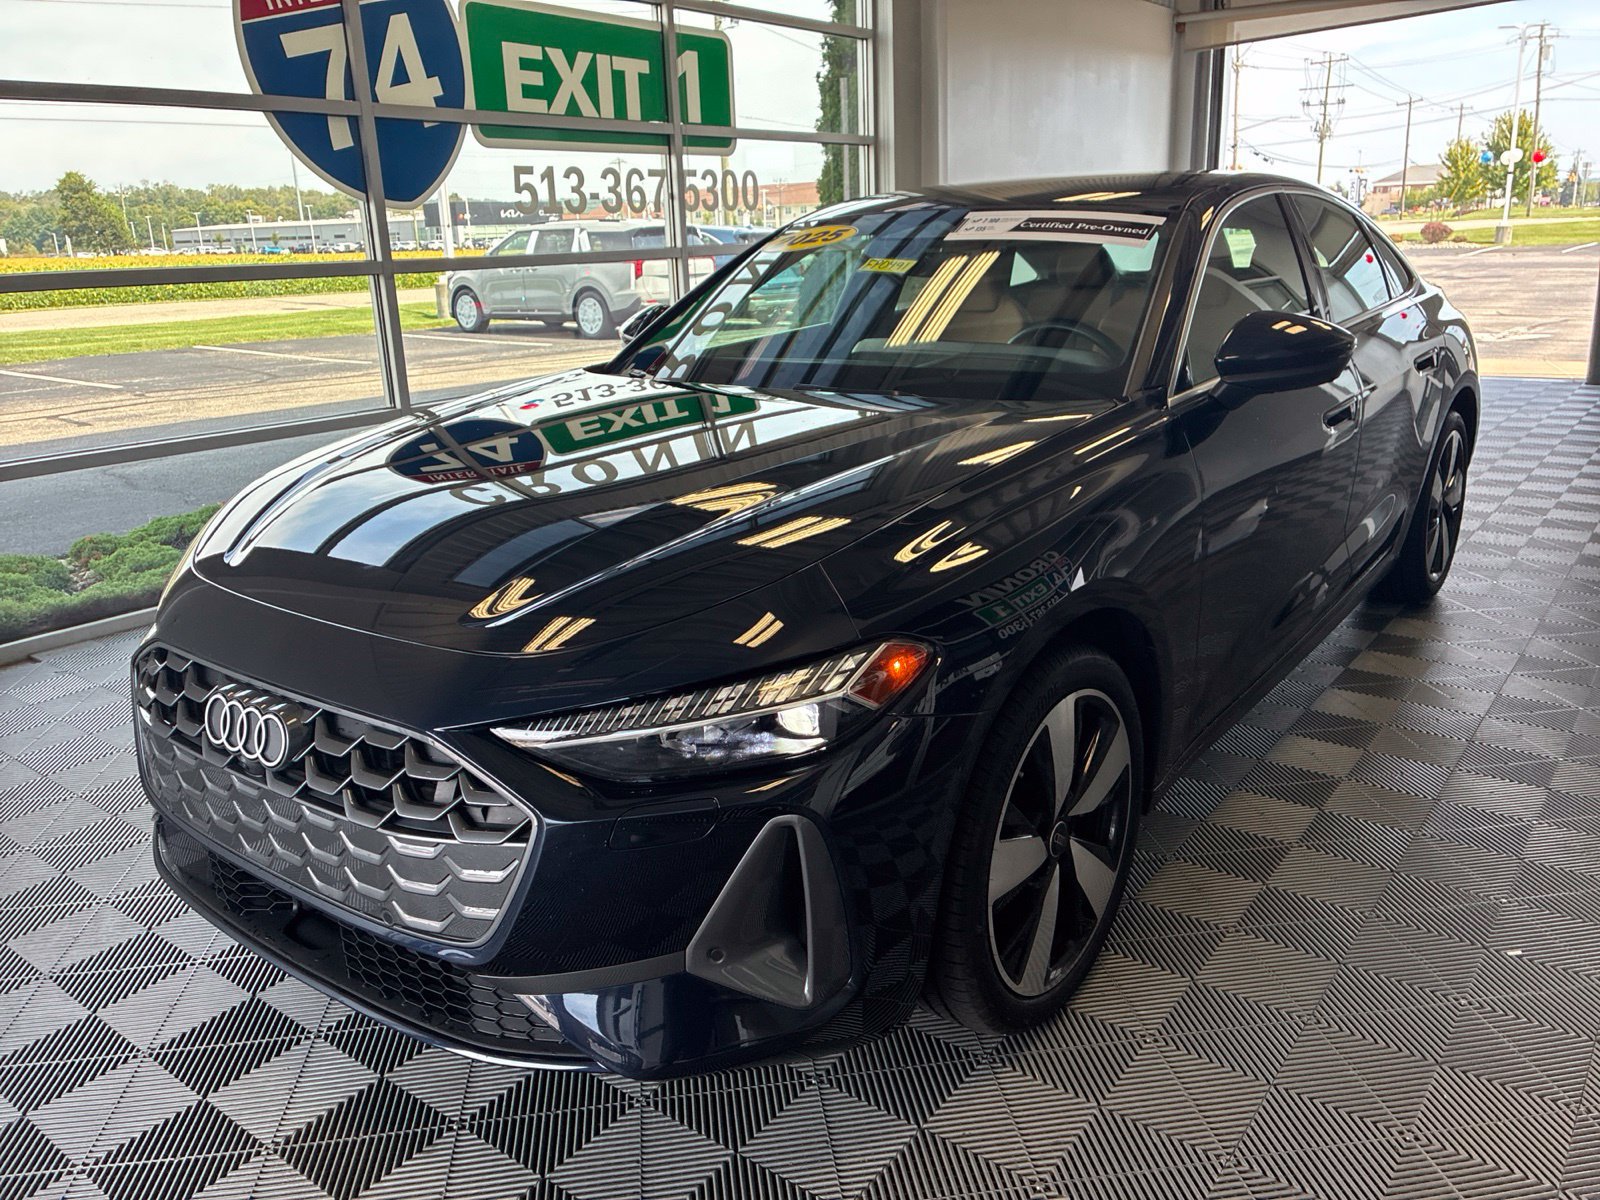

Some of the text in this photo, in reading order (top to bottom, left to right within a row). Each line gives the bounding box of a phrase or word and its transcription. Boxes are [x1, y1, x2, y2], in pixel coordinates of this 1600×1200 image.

[280, 12, 444, 151] 74
[501, 41, 702, 123] EXIT 1
[514, 165, 759, 215] 513-3675300
[1020, 221, 1149, 236] Certified Pre-Owned
